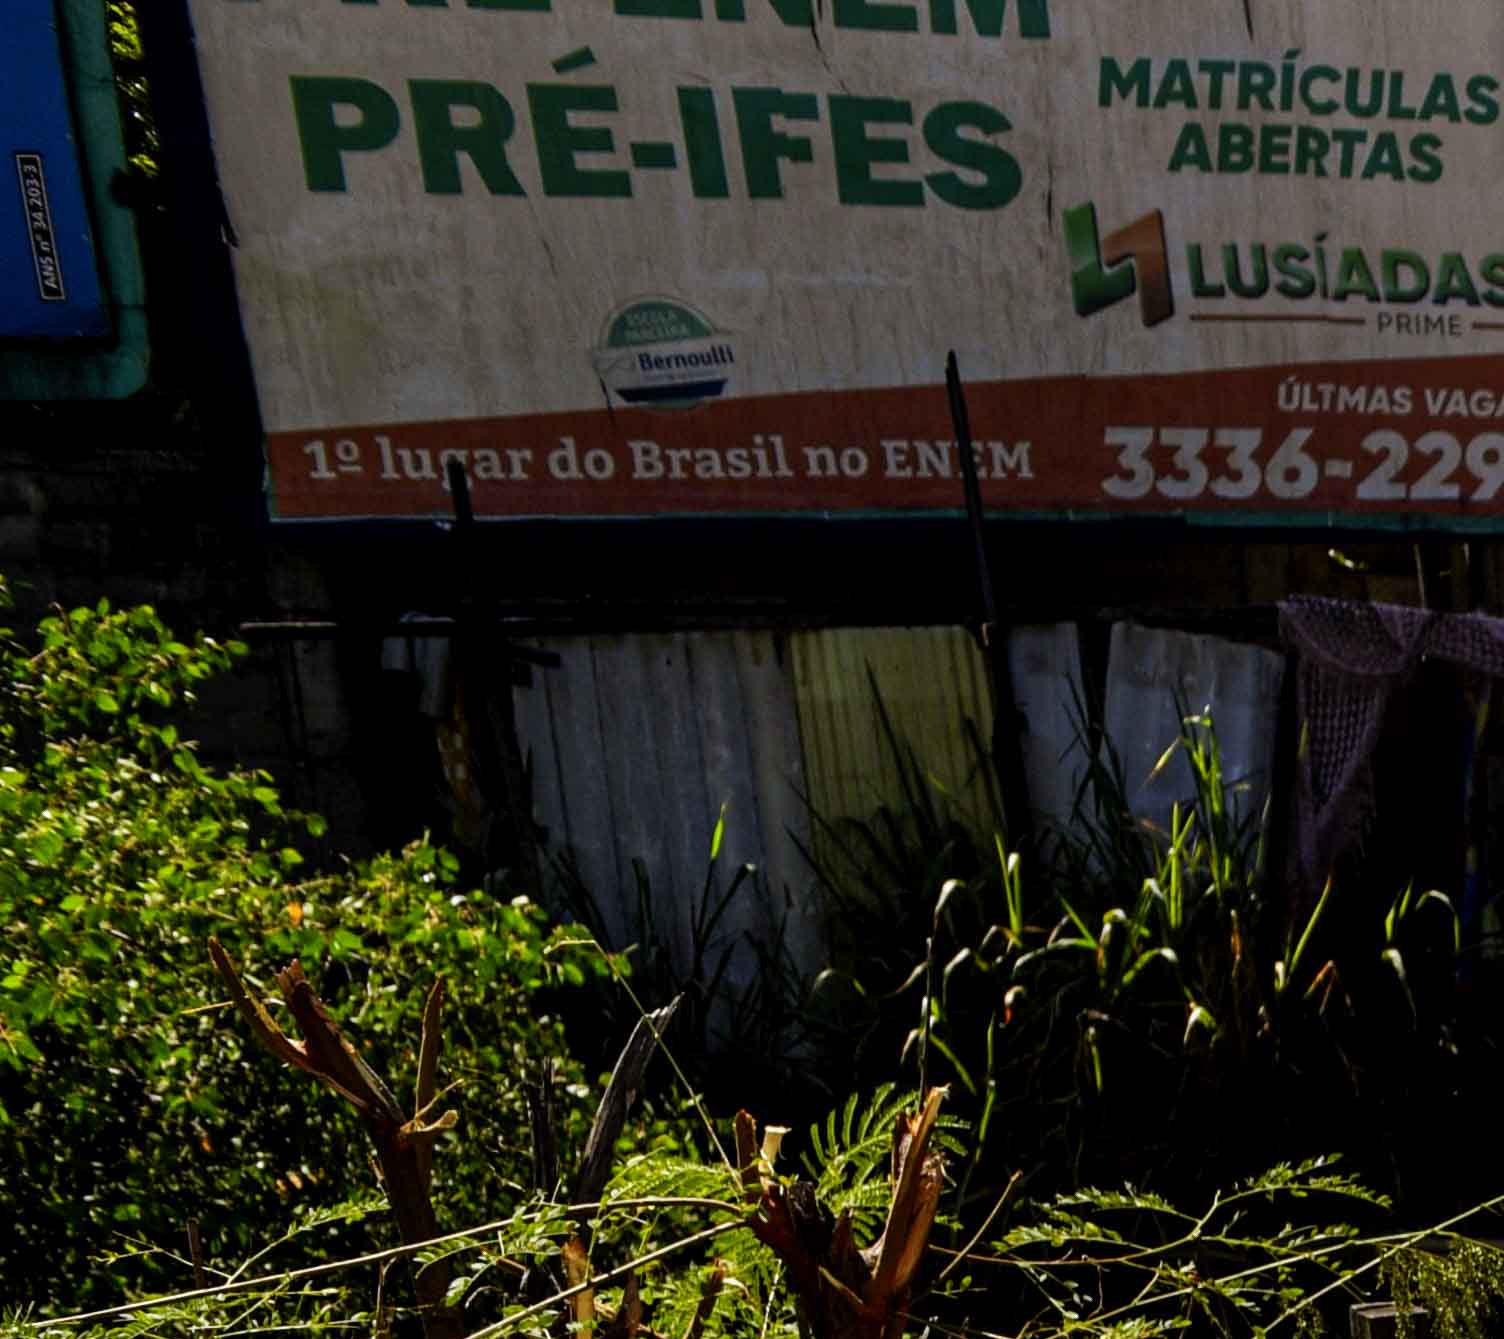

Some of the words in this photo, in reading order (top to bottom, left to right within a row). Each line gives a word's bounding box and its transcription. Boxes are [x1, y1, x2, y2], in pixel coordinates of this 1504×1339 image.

[1098, 48, 1501, 126] MATRÍCULAS
[289, 46, 1024, 211] PRÉ-IFES
[1167, 121, 1443, 183] ABERTAS
[39, 255, 58, 289] ANS
[1377, 311, 1463, 337] PRIME
[638, 343, 735, 371] Bernoulli
[304, 440, 362, 479] 1º
[381, 436, 533, 492] lugar
[547, 436, 616, 480] do
[627, 435, 793, 480] Brasil
[802, 444, 870, 479] no
[881, 438, 1035, 480] ENEM
